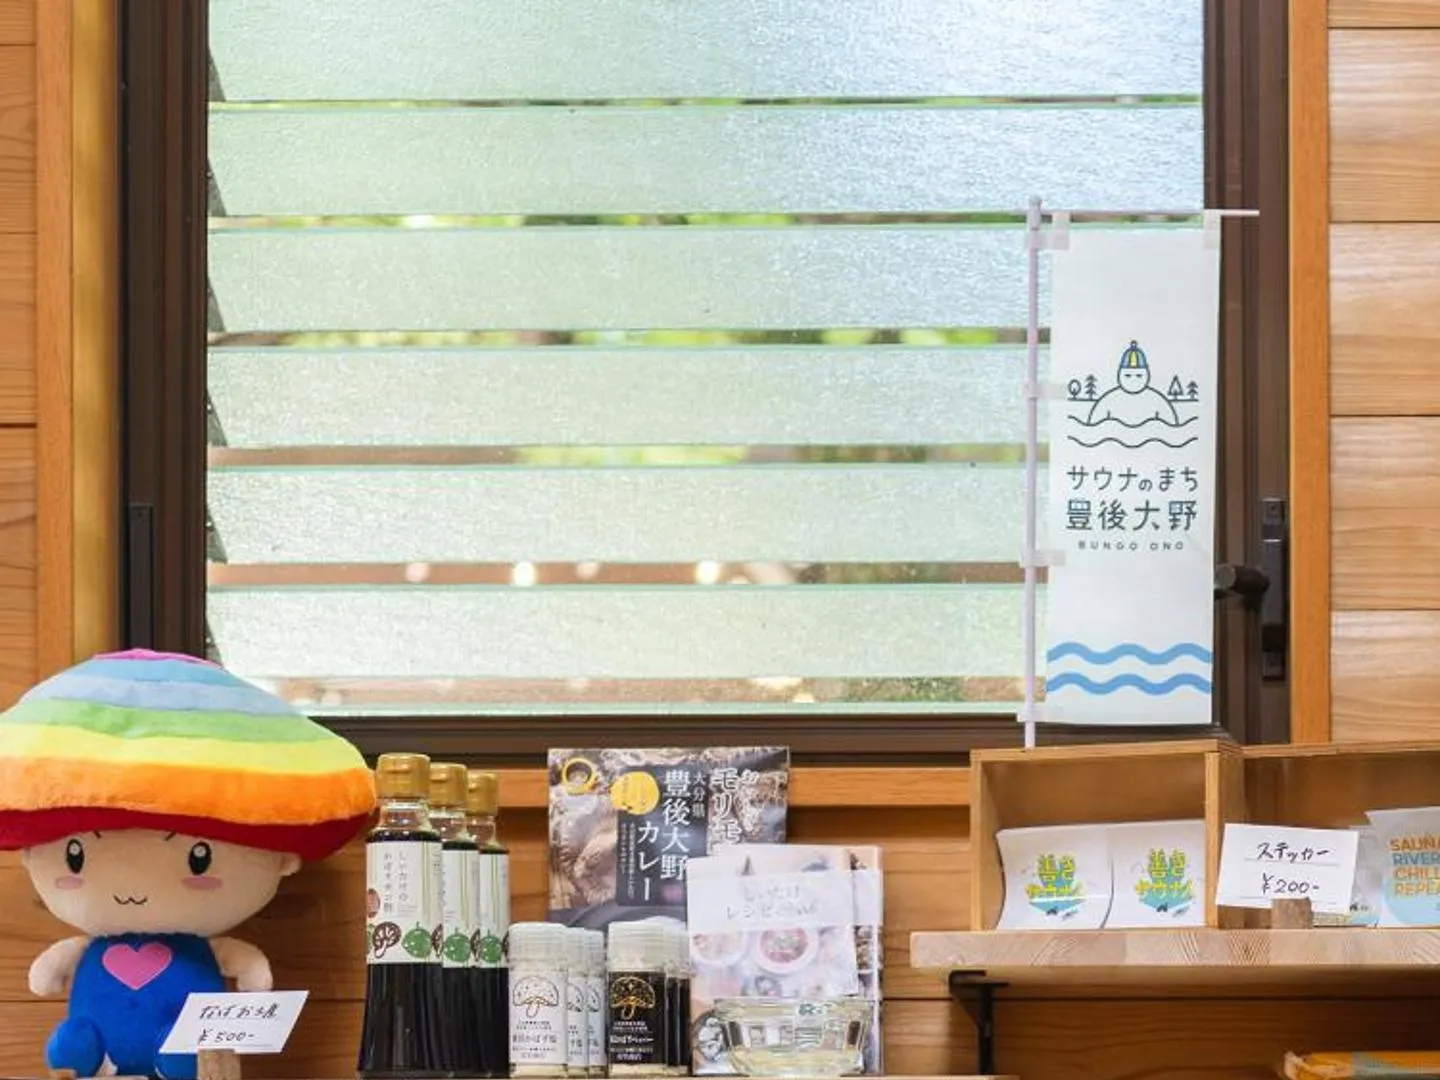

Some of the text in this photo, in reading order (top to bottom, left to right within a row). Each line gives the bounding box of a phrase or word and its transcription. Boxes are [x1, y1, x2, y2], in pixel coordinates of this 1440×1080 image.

[1066, 466, 1198, 492] サウナのまち
[1066, 499, 1197, 531] 豊後大野
[1078, 541, 1184, 551] BUNGO ONO
[661, 769, 691, 881] 豊後大野
[638, 821, 661, 901] カレー
[1257, 842, 1330, 863] ステッカー
